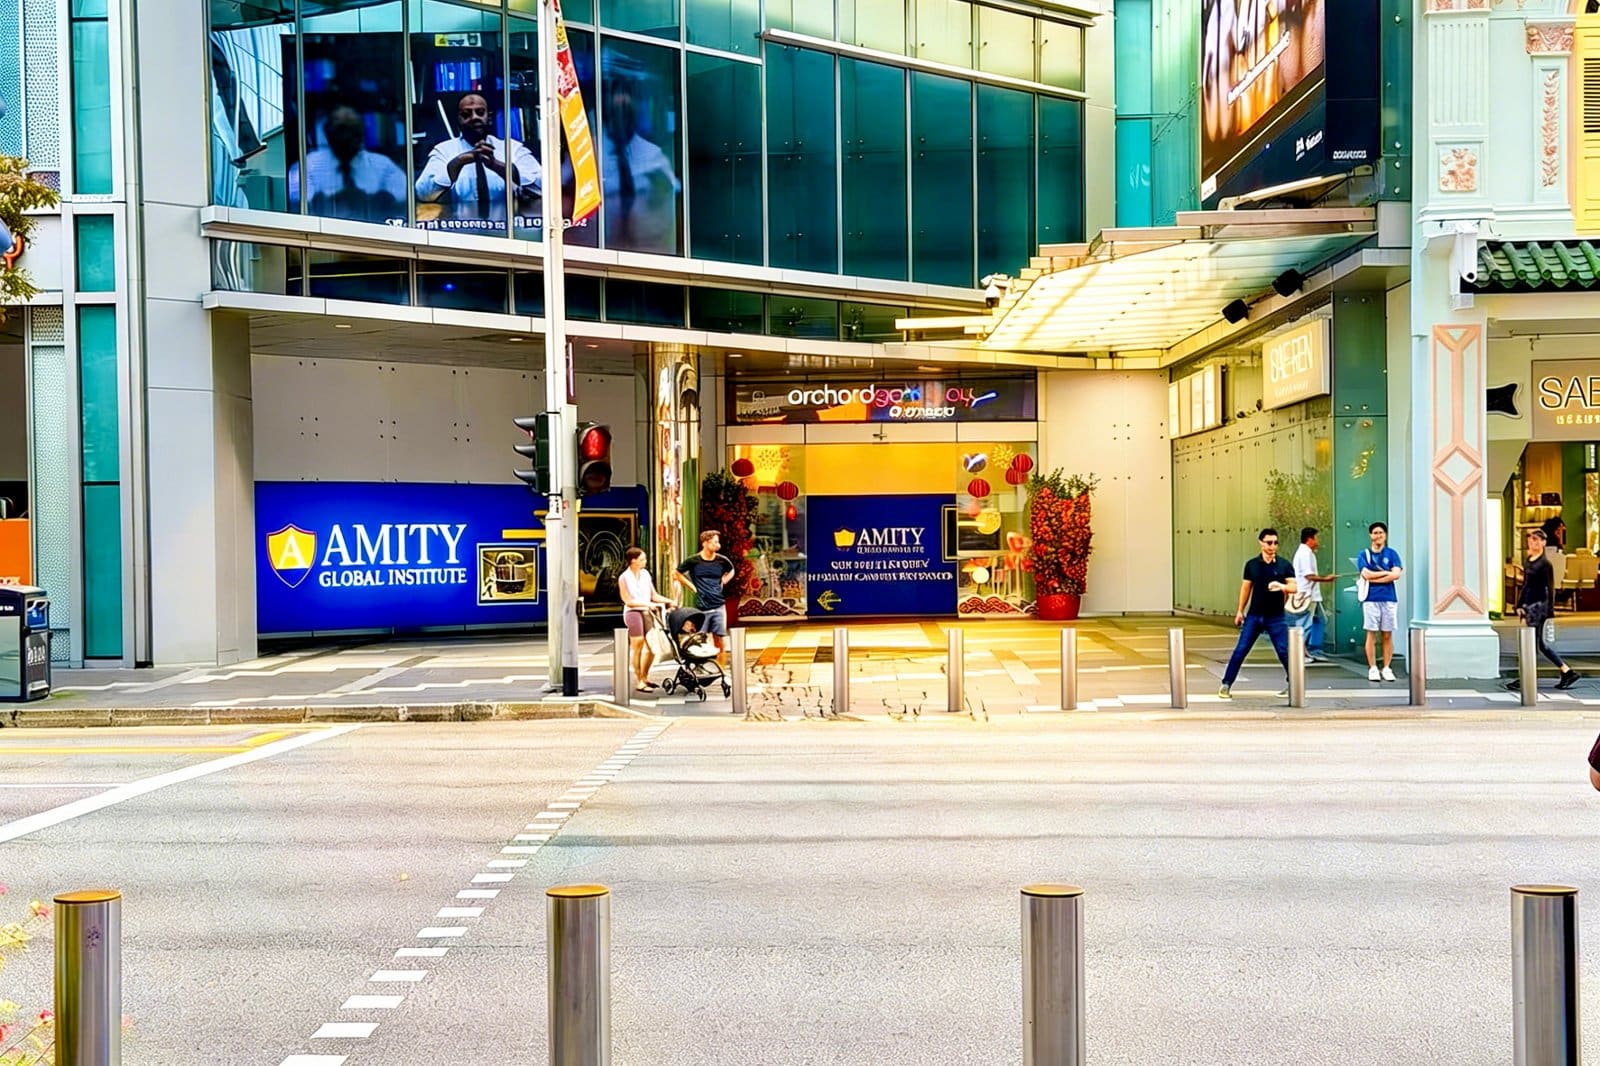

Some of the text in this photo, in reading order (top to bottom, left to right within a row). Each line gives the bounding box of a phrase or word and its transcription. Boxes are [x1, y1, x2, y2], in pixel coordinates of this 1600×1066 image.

[1538, 375, 1600, 411] SAE
[320, 523, 468, 567] AMITY
[856, 527, 925, 546] AMITY
[318, 567, 468, 588] GLOBAL INSTITUTE
